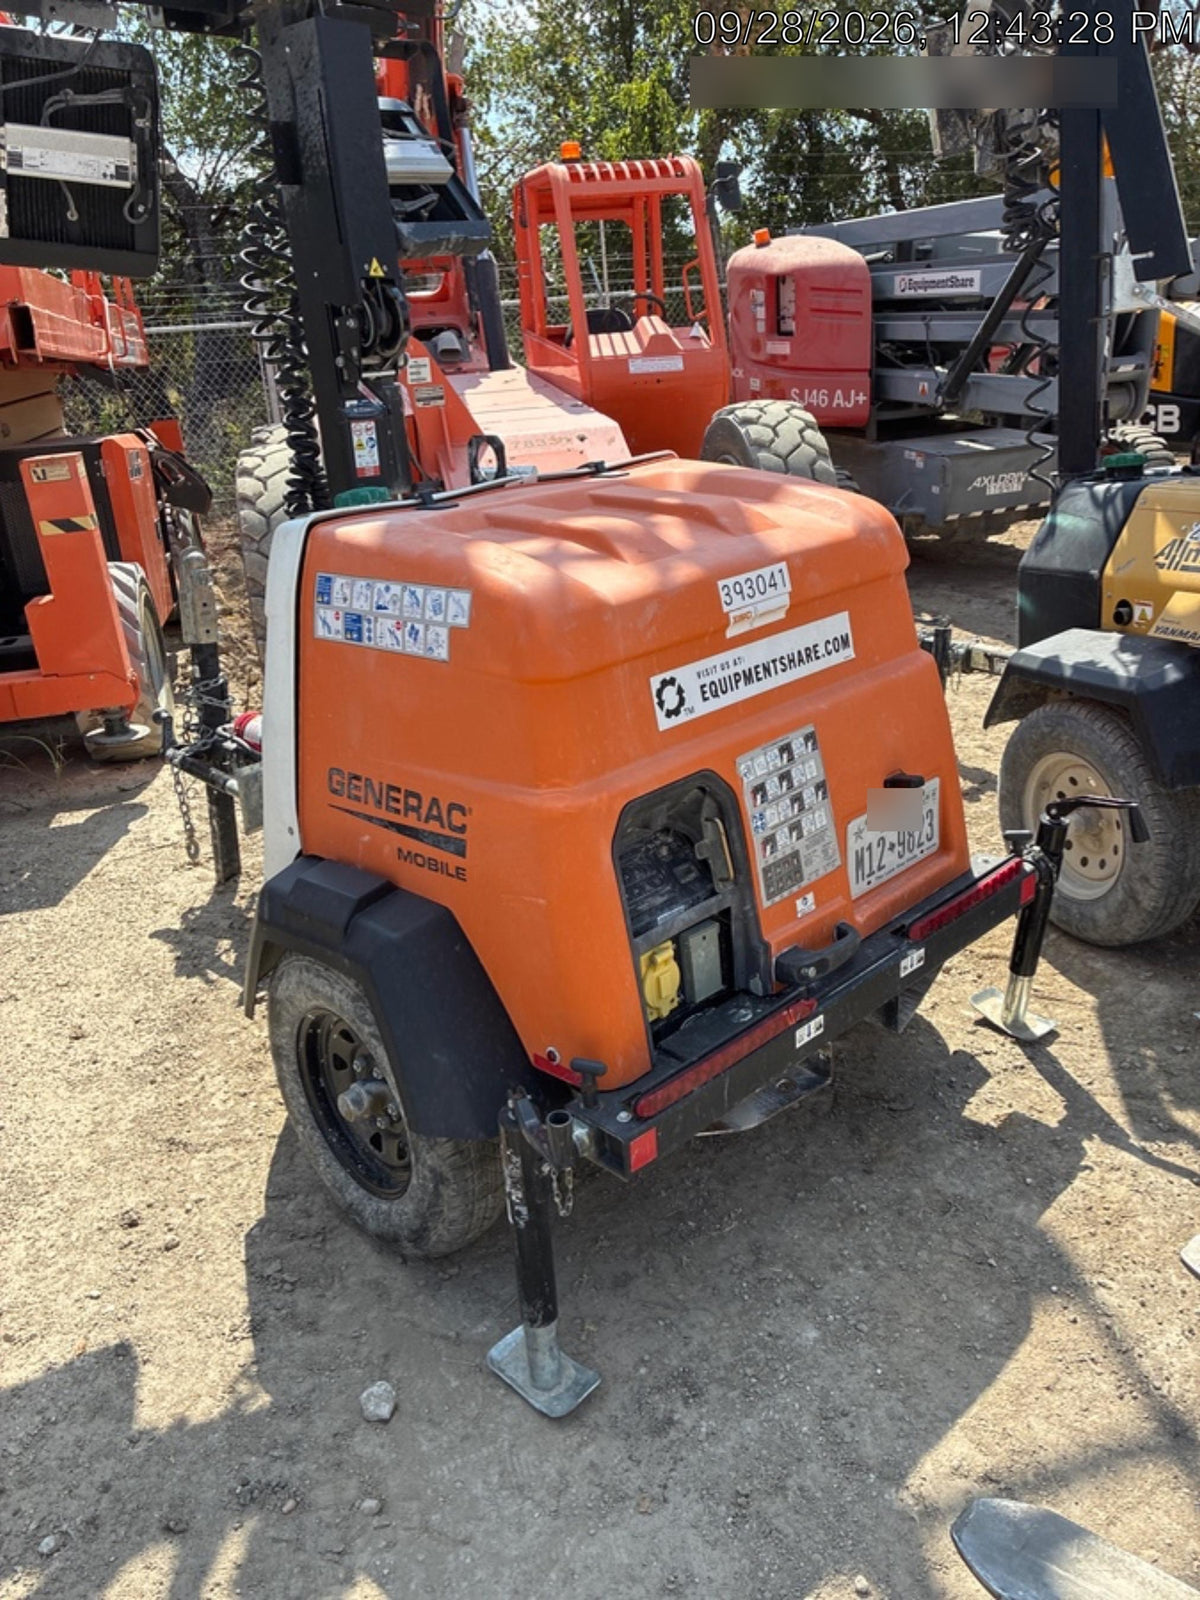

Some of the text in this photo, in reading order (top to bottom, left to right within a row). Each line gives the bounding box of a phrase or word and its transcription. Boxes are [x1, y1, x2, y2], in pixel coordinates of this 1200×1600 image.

[907, 275, 975, 291] EquipmentShare
[832, 388, 867, 408] AJ+
[721, 568, 787, 607] 393041
[696, 665, 718, 679] VISIT
[720, 662, 730, 671] US
[699, 632, 850, 703] EQUIPMENTSHARE.COM
[328, 767, 467, 834] GENERAC
[397, 847, 467, 882] MOBILE
